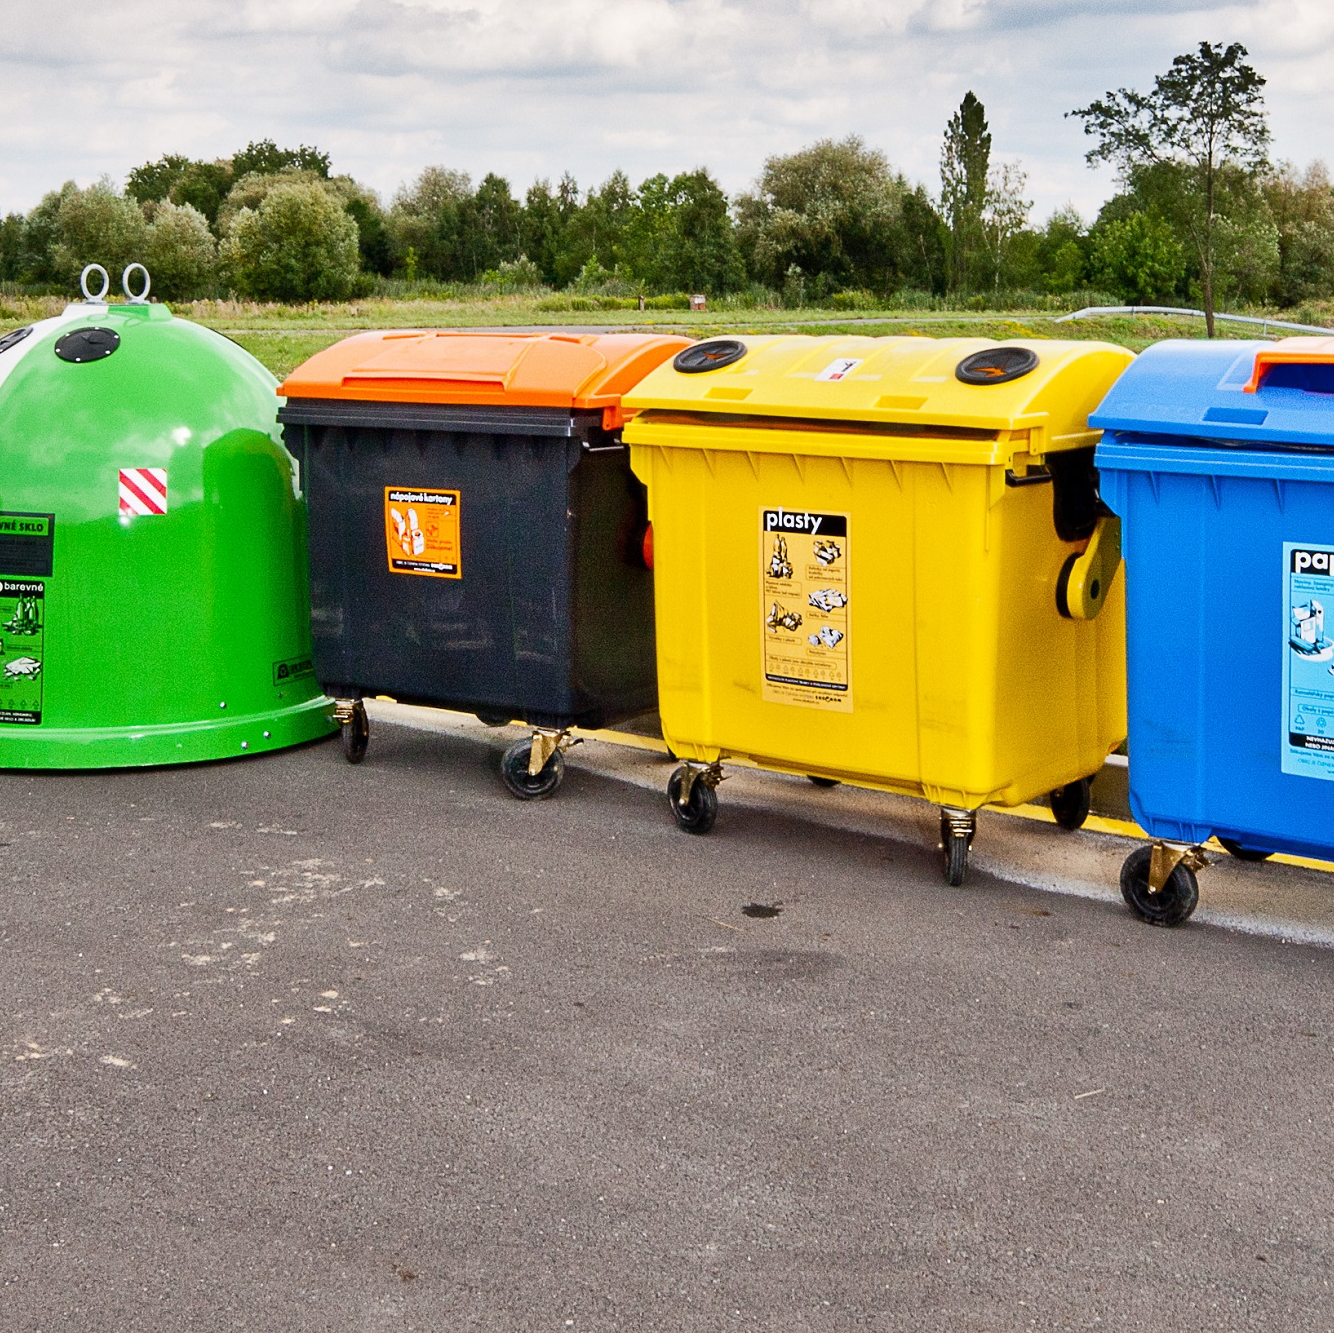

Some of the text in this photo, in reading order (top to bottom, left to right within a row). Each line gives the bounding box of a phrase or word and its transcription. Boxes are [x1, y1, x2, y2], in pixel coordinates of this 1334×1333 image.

[424, 492, 453, 505] kartony
[766, 506, 823, 535] plasty
[19, 522, 44, 532] SKLO
[4, 582, 44, 592] barevné
